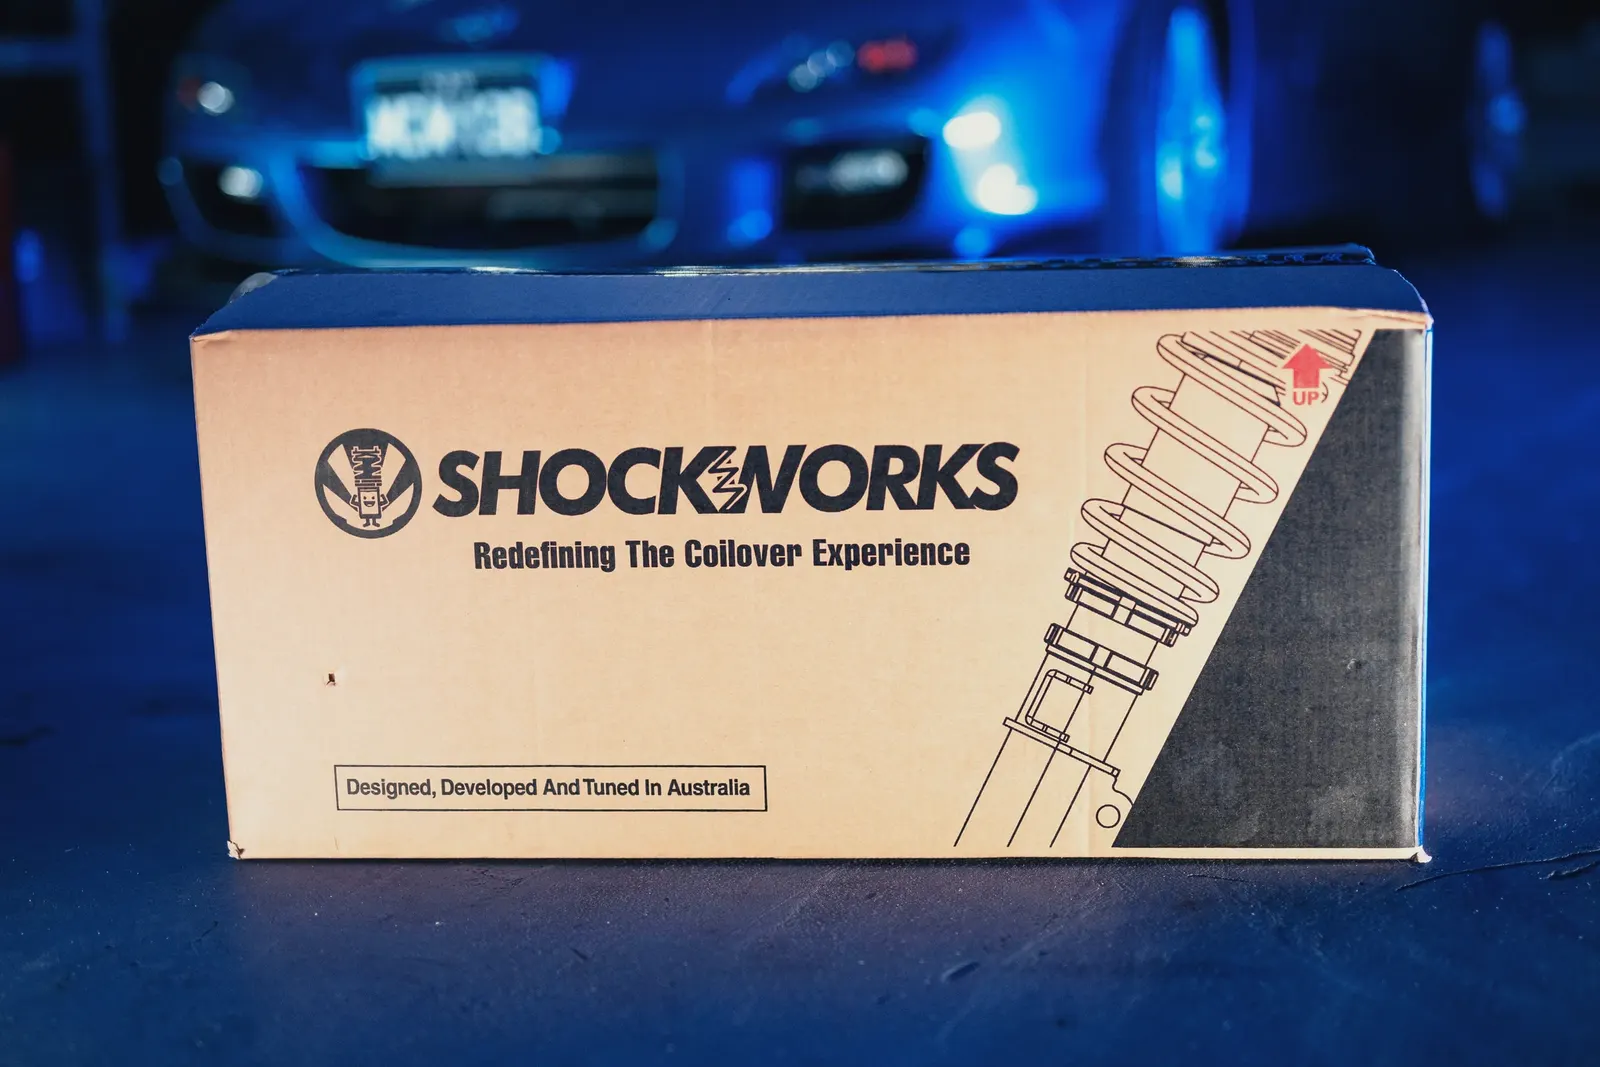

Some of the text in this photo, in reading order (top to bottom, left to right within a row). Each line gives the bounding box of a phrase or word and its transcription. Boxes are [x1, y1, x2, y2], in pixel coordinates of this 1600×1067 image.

[1293, 391, 1319, 406] UP
[432, 442, 1020, 517] SHOCKWORKS
[474, 538, 971, 573] Redefining The Coilover Experience
[346, 778, 750, 800] Designed, Developed And Tuned In Australia
